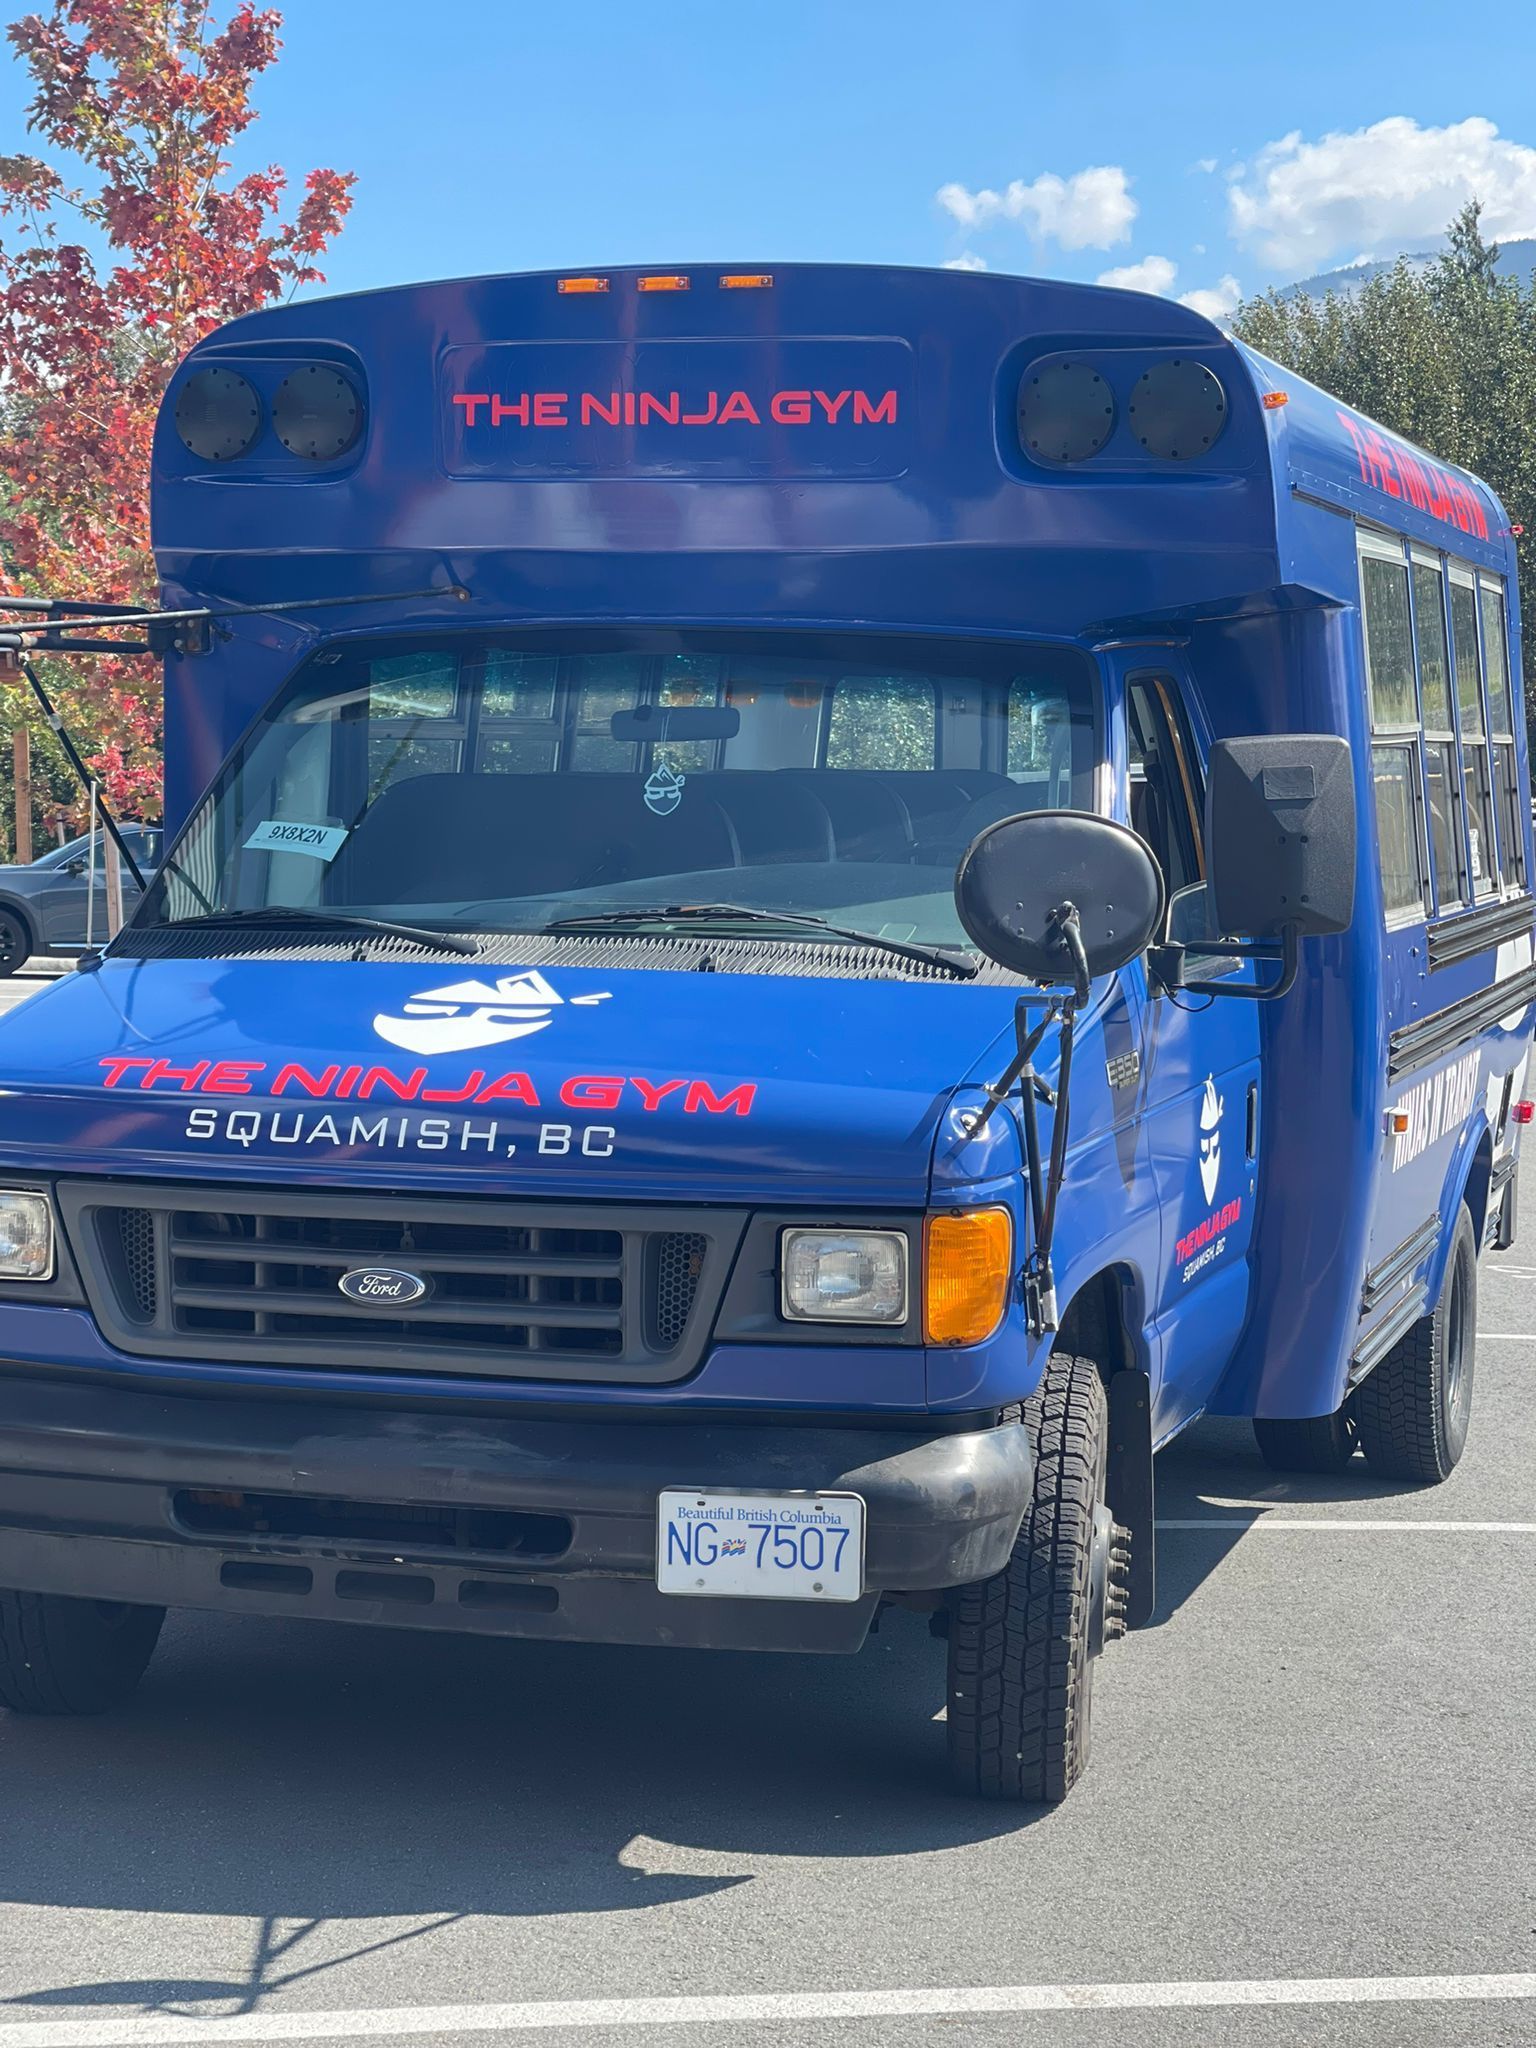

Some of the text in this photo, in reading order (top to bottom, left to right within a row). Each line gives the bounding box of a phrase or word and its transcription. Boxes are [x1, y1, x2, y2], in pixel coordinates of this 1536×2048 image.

[453, 391, 897, 426] THE NINJA GYM
[1336, 411, 1400, 498] THE
[268, 825, 328, 844] 9X8X2N
[99, 1057, 757, 1116] THE NINJA GYM
[185, 1108, 615, 1158] SQUAMISH, BC
[358, 1274, 402, 1296] Ford
[677, 1507, 842, 1525] Beautiful British Columbia
[668, 1522, 850, 1573] NG 7507
